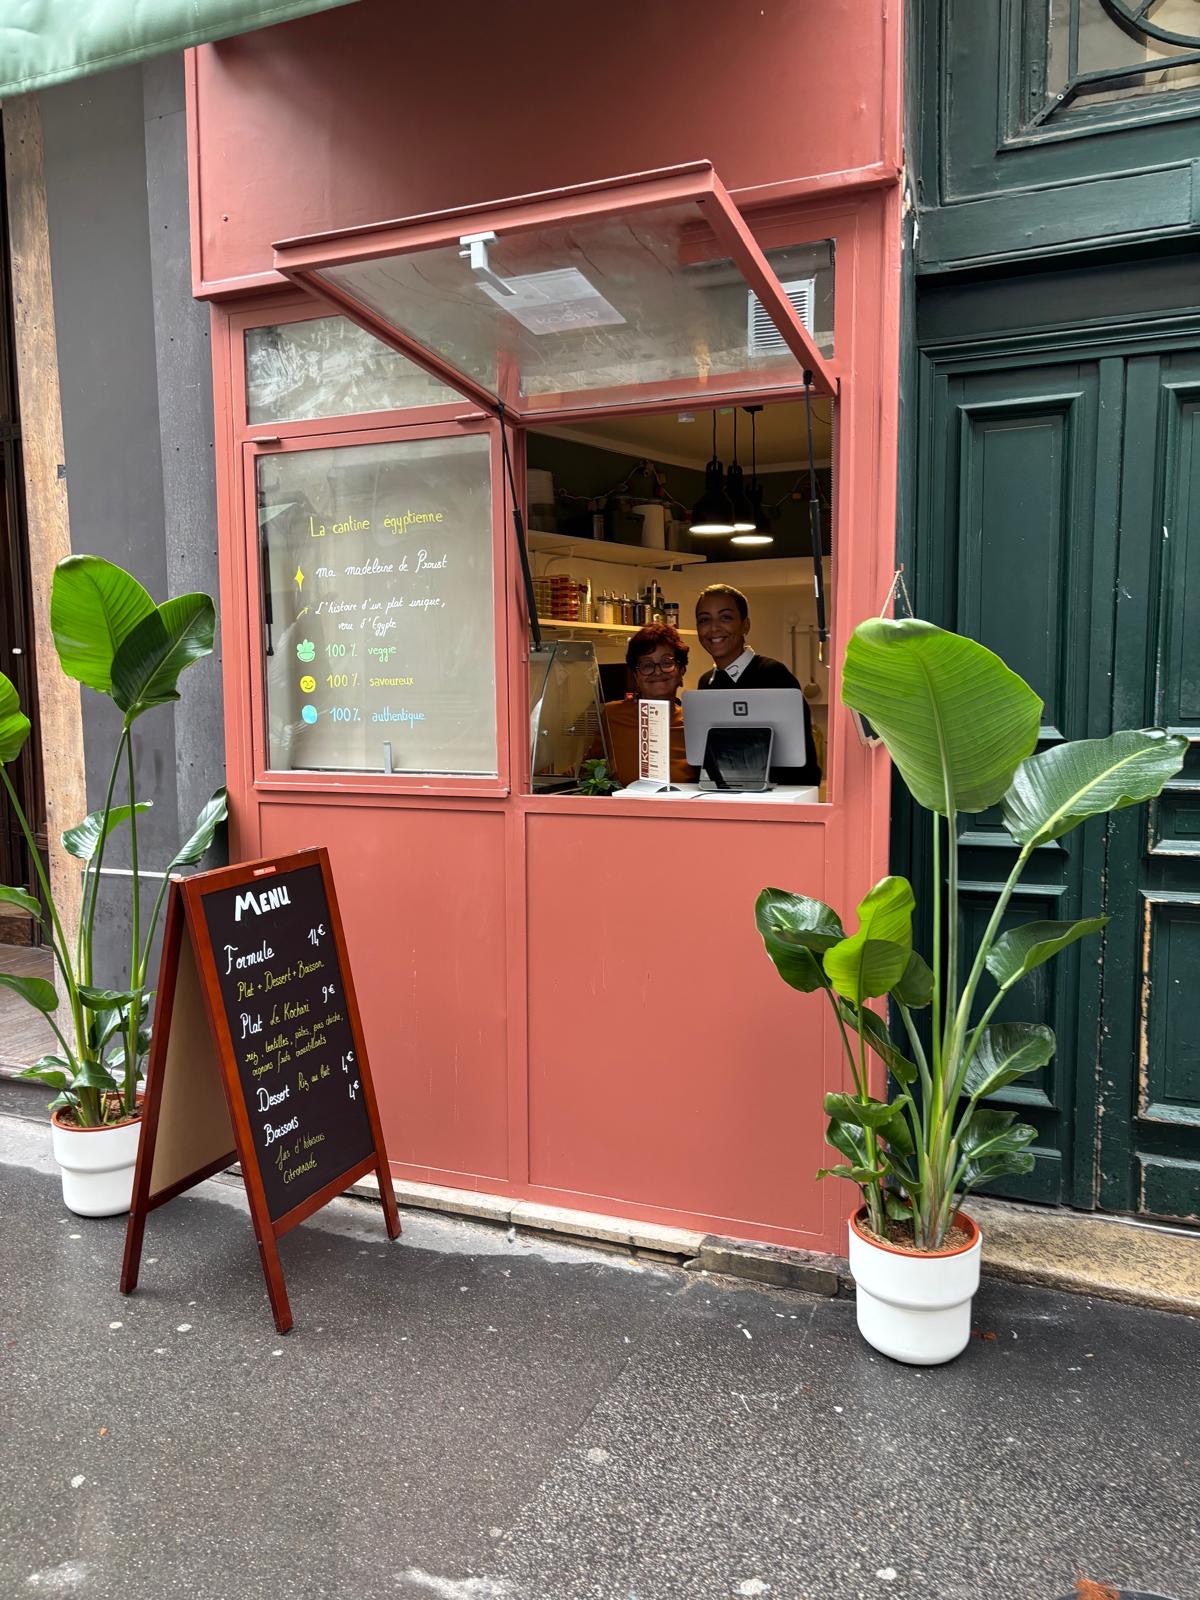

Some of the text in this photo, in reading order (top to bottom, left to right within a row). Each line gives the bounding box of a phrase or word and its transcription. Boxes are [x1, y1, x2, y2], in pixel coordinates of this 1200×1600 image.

[310, 510, 443, 537] La cantine égyptienne
[345, 558, 394, 576] madeleine
[399, 555, 408, 572] de
[415, 549, 448, 573] Proust
[386, 597, 404, 614] plat
[409, 598, 445, 611] unique,
[338, 621, 354, 630] venu
[368, 646, 397, 662] veggie
[369, 676, 414, 687] savoureux
[372, 706, 425, 729] authentique
[234, 885, 291, 922] MENU
[224, 940, 275, 975] Formule
[237, 981, 254, 1001] Plat
[264, 967, 292, 992] Dessert
[298, 959, 324, 979] Boisson
[240, 1012, 262, 1039] Plat
[284, 1000, 310, 1021] Kochari
[256, 1085, 290, 1112] Dessert
[264, 1116, 299, 1147] Boissons
[283, 1152, 318, 1184] Citronnade
